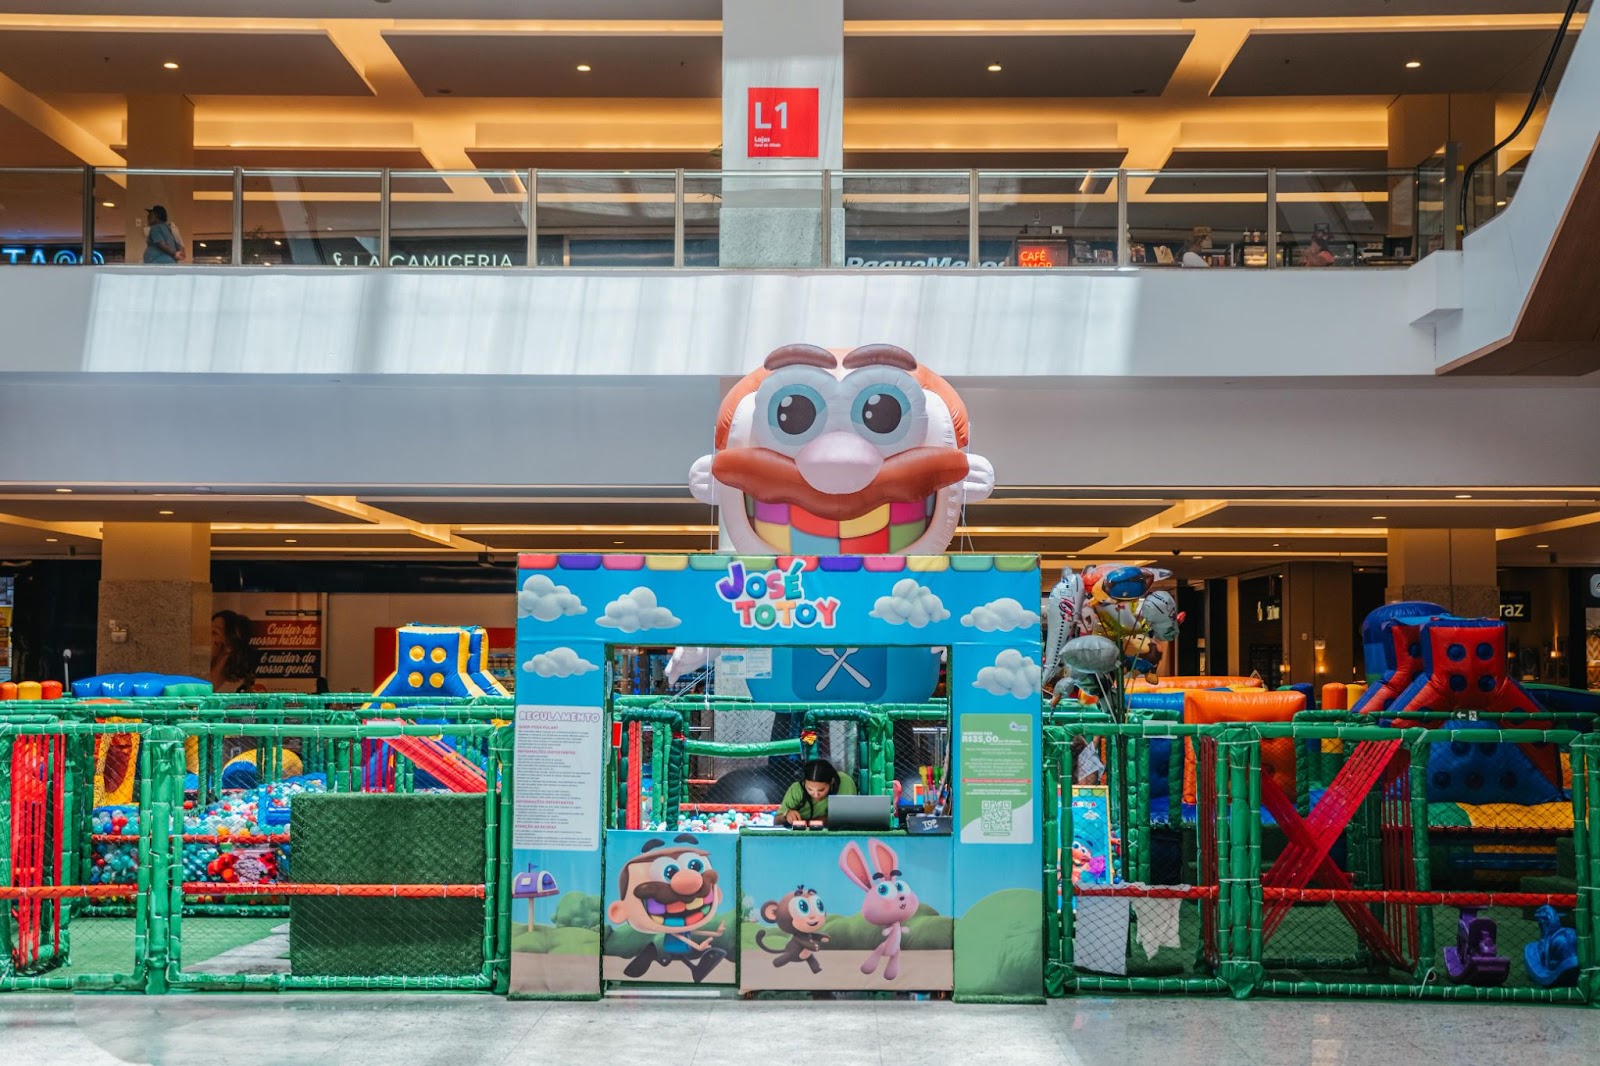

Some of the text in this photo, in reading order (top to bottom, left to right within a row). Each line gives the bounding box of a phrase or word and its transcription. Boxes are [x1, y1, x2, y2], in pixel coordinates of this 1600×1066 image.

[755, 102, 787, 129] L1
[1020, 250, 1046, 261] CAFÉ
[716, 559, 804, 601] JOSÉ
[733, 598, 840, 629] TOTOY
[267, 623, 317, 635] Cuidar da
[249, 634, 317, 646] nossa história
[268, 652, 301, 663] cuidar
[302, 652, 316, 663] da
[256, 665, 284, 674] nossa
[519, 711, 601, 723] REGULAMENTO
